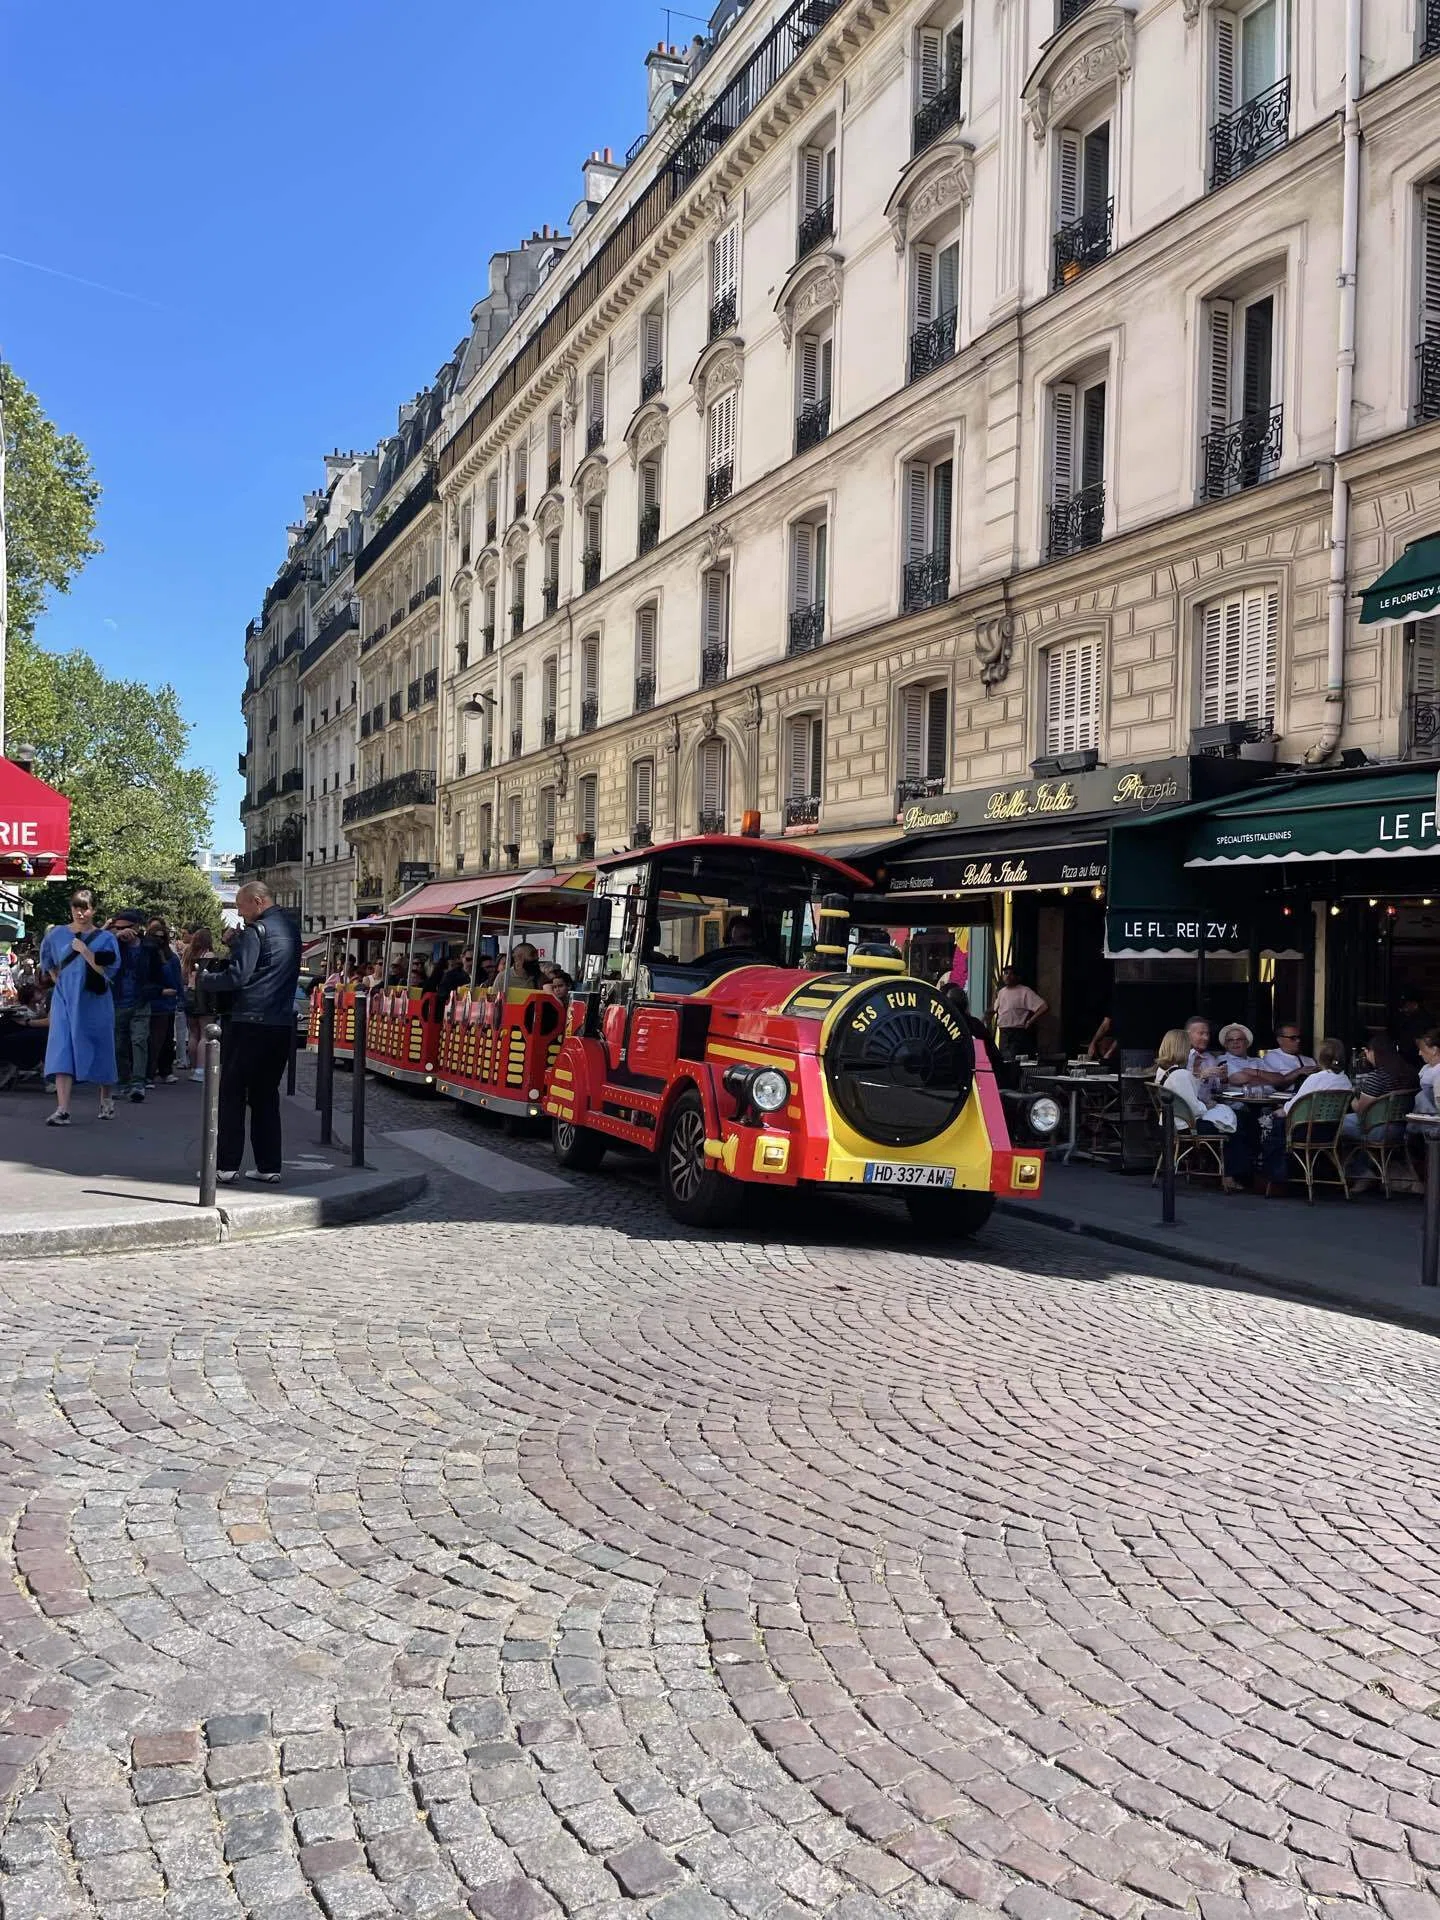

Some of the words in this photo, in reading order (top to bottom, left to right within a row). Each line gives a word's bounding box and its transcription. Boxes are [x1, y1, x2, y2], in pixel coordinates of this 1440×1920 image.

[1380, 598, 1390, 609] LE
[984, 789, 1029, 819] Bella
[1028, 782, 1074, 813] Italia
[1113, 773, 1177, 812] Pizzeria
[0, 821, 38, 846] RIE
[1254, 830, 1292, 842] ITALIENNES
[1380, 814, 1410, 840] LE
[1420, 811, 1440, 838] F
[961, 863, 992, 885] Bella
[994, 860, 1028, 883] Italia
[1061, 865, 1078, 878] Pizza
[1079, 866, 1088, 877] au
[1089, 862, 1100, 876] feu
[1125, 922, 1143, 937] LE
[851, 1005, 878, 1032] STS
[886, 991, 917, 1009] FUN
[929, 999, 961, 1041] TRAIN
